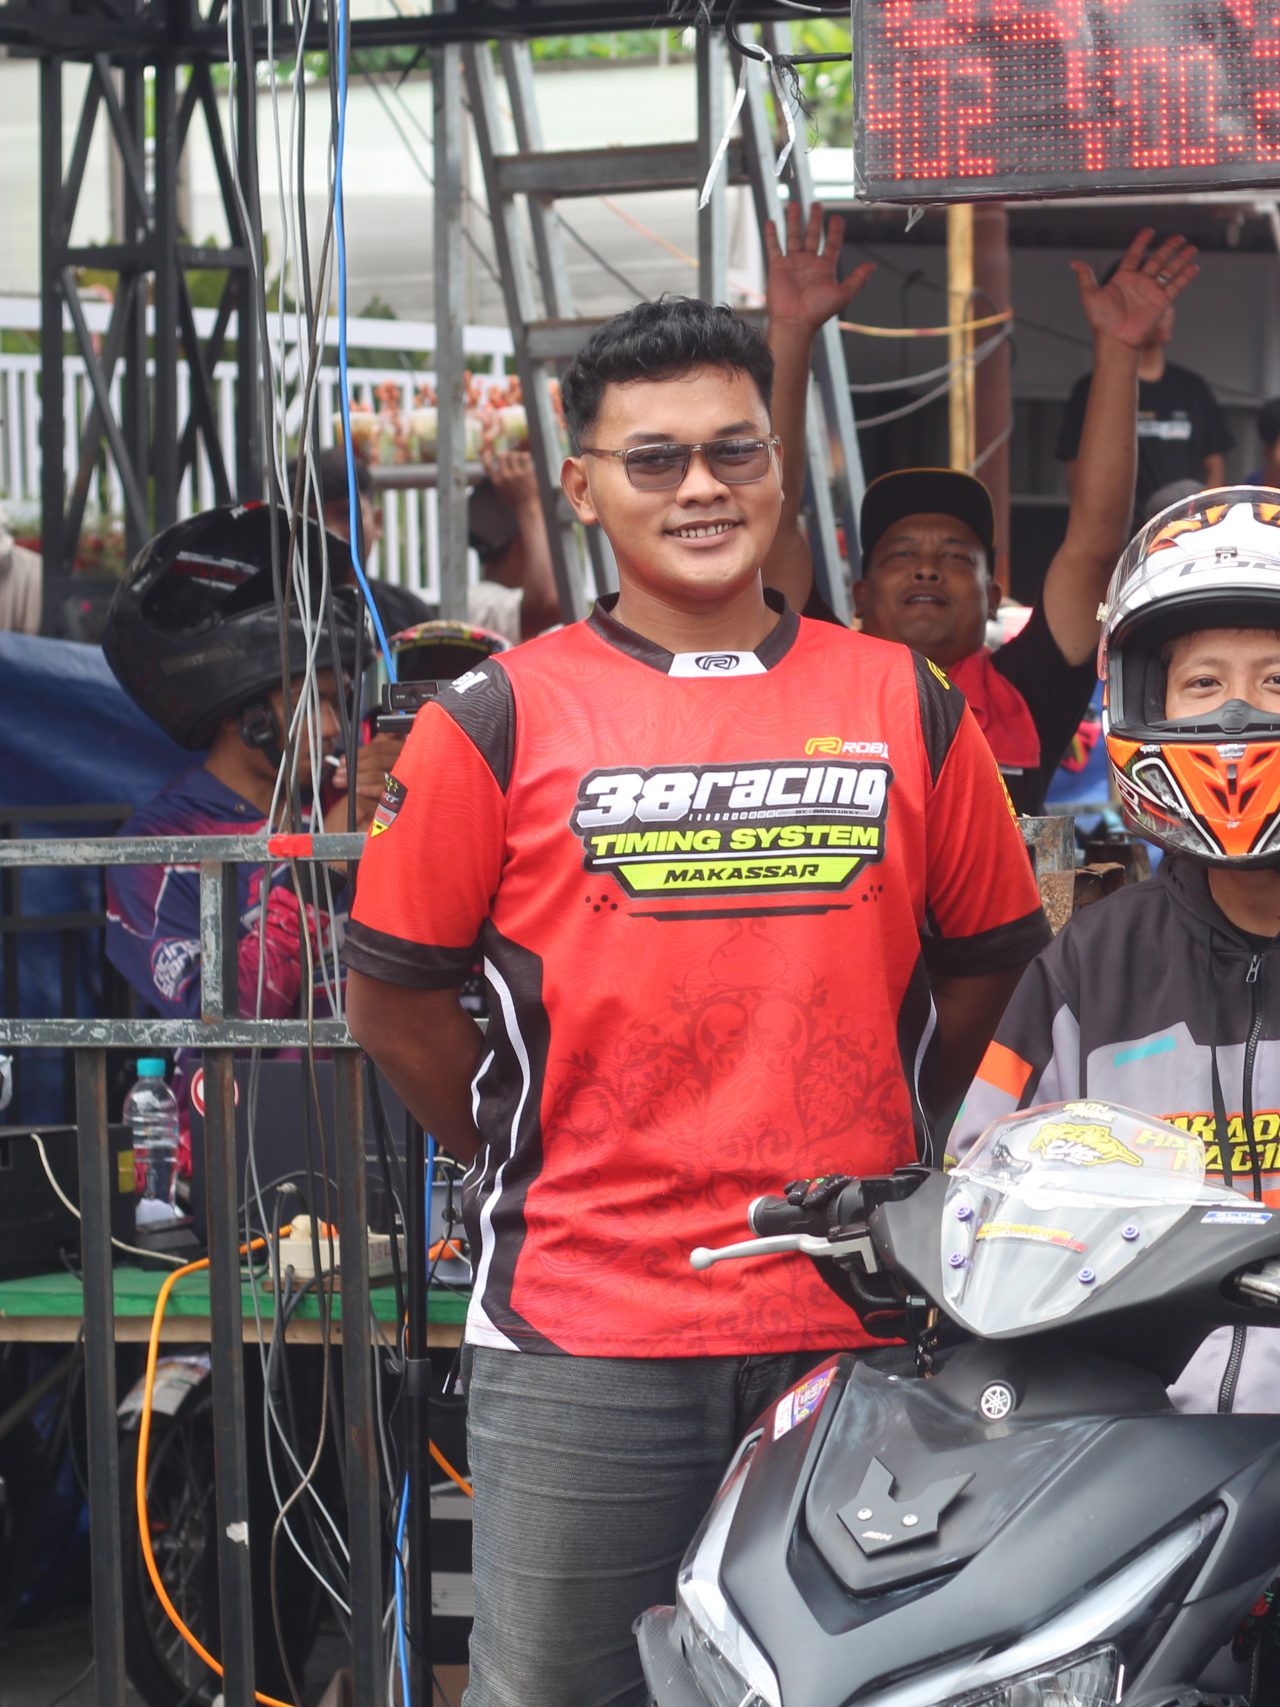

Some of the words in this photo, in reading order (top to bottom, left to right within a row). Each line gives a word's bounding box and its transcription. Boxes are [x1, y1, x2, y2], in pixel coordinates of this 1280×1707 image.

[591, 828, 722, 856] TIMING
[729, 824, 880, 850] SYSTEM
[663, 863, 819, 885] MAKASSAR
